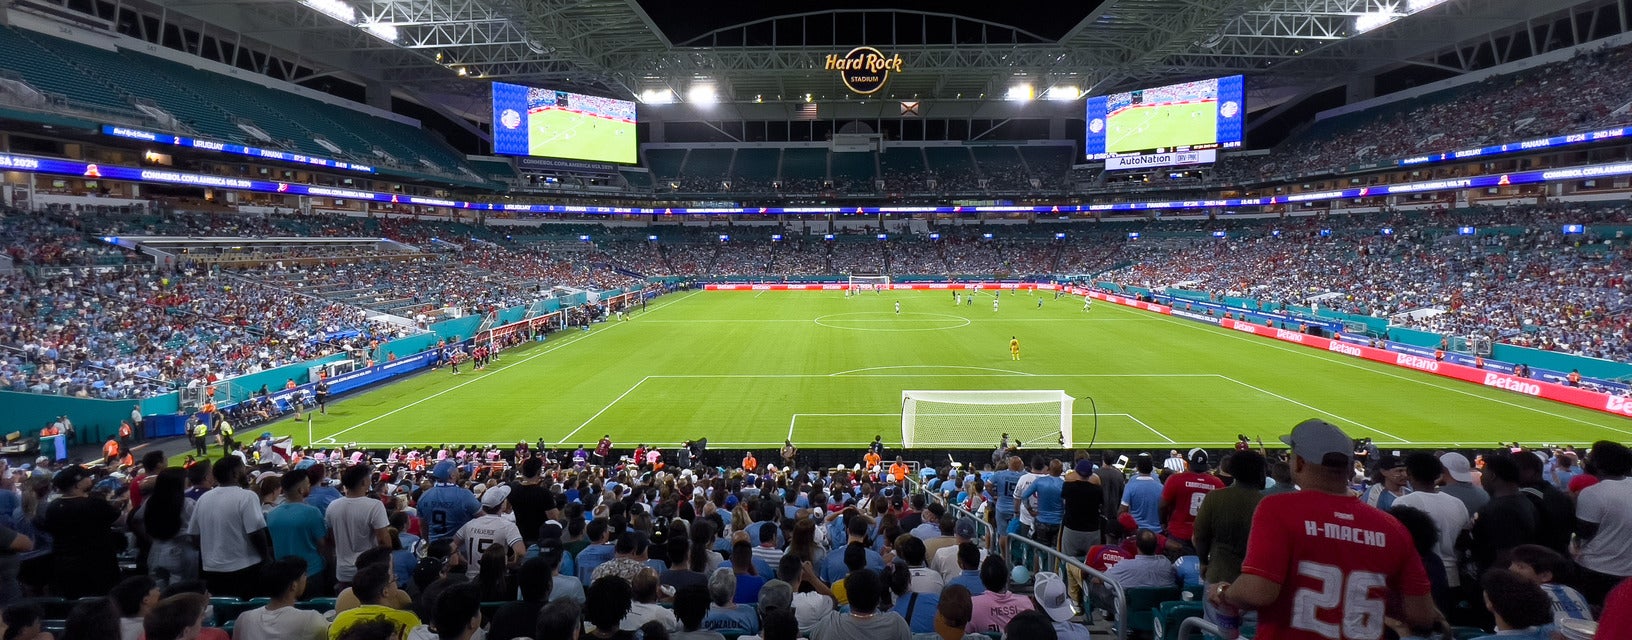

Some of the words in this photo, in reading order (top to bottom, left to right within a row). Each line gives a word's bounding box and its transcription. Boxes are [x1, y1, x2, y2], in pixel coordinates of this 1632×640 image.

[825, 53, 864, 70] Hard
[866, 53, 902, 73] Rock
[174, 136, 180, 144] 2
[1566, 134, 1585, 142] 87:24
[1593, 131, 1608, 139] 2ND
[193, 140, 224, 151] URUGUAY
[1521, 139, 1549, 149] PANAMA
[261, 149, 283, 159] PANAMA
[1455, 149, 1482, 158] URUGUAY
[13, 159, 38, 168] 2024
[523, 158, 553, 167] CONMEBOL
[1119, 155, 1171, 165] AutoNation
[142, 170, 181, 181] CONMEBOL
[181, 174, 198, 183] COPA
[199, 175, 226, 186] AMERICA
[1543, 169, 1582, 179] CONMEBOL
[1583, 166, 1604, 176] COPA
[1233, 321, 1255, 334] Betano
[1276, 328, 1303, 343] Betano
[1329, 341, 1361, 357] Betano
[1397, 352, 1438, 371] Betano
[1484, 372, 1541, 396] Betano
[431, 510, 447, 534] 9
[1304, 520, 1386, 548] H-MACHO
[1290, 559, 1387, 640] 26
[990, 605, 1018, 616] MESSI
